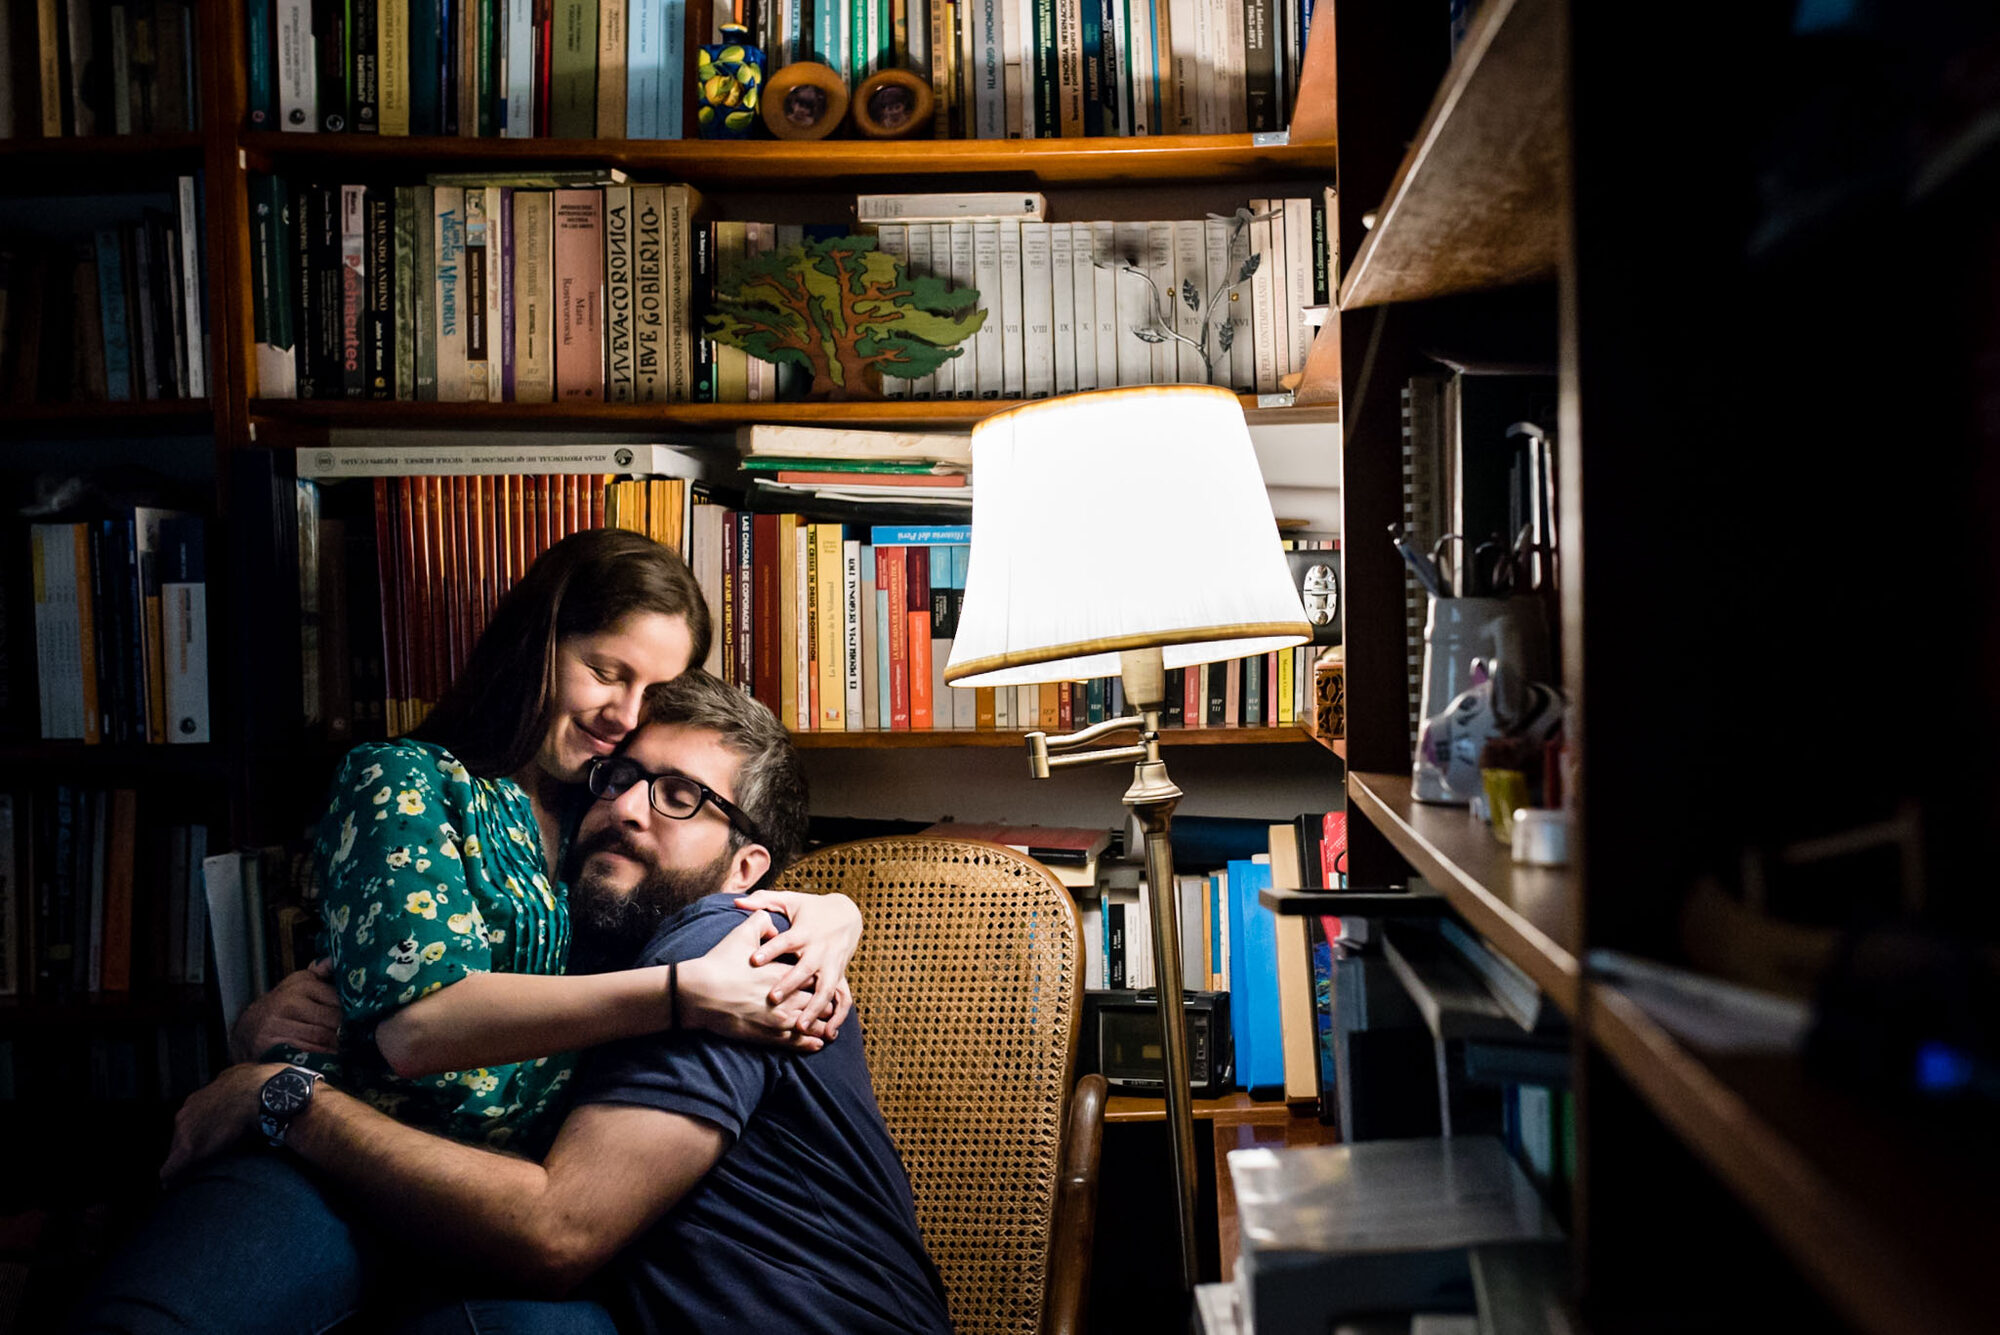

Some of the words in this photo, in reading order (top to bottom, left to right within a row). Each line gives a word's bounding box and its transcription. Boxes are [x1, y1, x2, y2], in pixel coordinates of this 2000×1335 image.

[986, 47, 996, 90] GROWTH
[1088, 56, 1098, 101] PARAGUAY
[377, 201, 387, 213] EL
[1314, 210, 1323, 230] Andes
[378, 219, 388, 264] MUNDO
[1315, 231, 1323, 242] des
[1316, 270, 1324, 279] les
[379, 266, 388, 312] ANDINO
[438, 265, 457, 336] MEMORIAS
[344, 254, 361, 372] Pachacutec
[562, 278, 573, 346] Rostworowski
[1259, 277, 1270, 348] CONTEMPORÁNEO
[1006, 325, 1018, 333] VII
[1032, 325, 1048, 334] VIII
[1060, 324, 1069, 332] IX
[1082, 323, 1089, 331] X
[1264, 371, 1271, 382] EL
[741, 516, 750, 531] LAS
[897, 532, 916, 541] Perú
[918, 532, 930, 540] del
[933, 532, 964, 540] Historia
[742, 532, 750, 569] CHACRAS
[742, 570, 750, 581] DE
[809, 574, 816, 583] IN
[724, 574, 732, 602] SAFARI
[741, 583, 750, 631] COPORAQUE
[848, 580, 856, 623] REGIONAL
[849, 627, 857, 677] PROBLEMA
[893, 651, 899, 660] LA
[850, 680, 857, 690] EL
